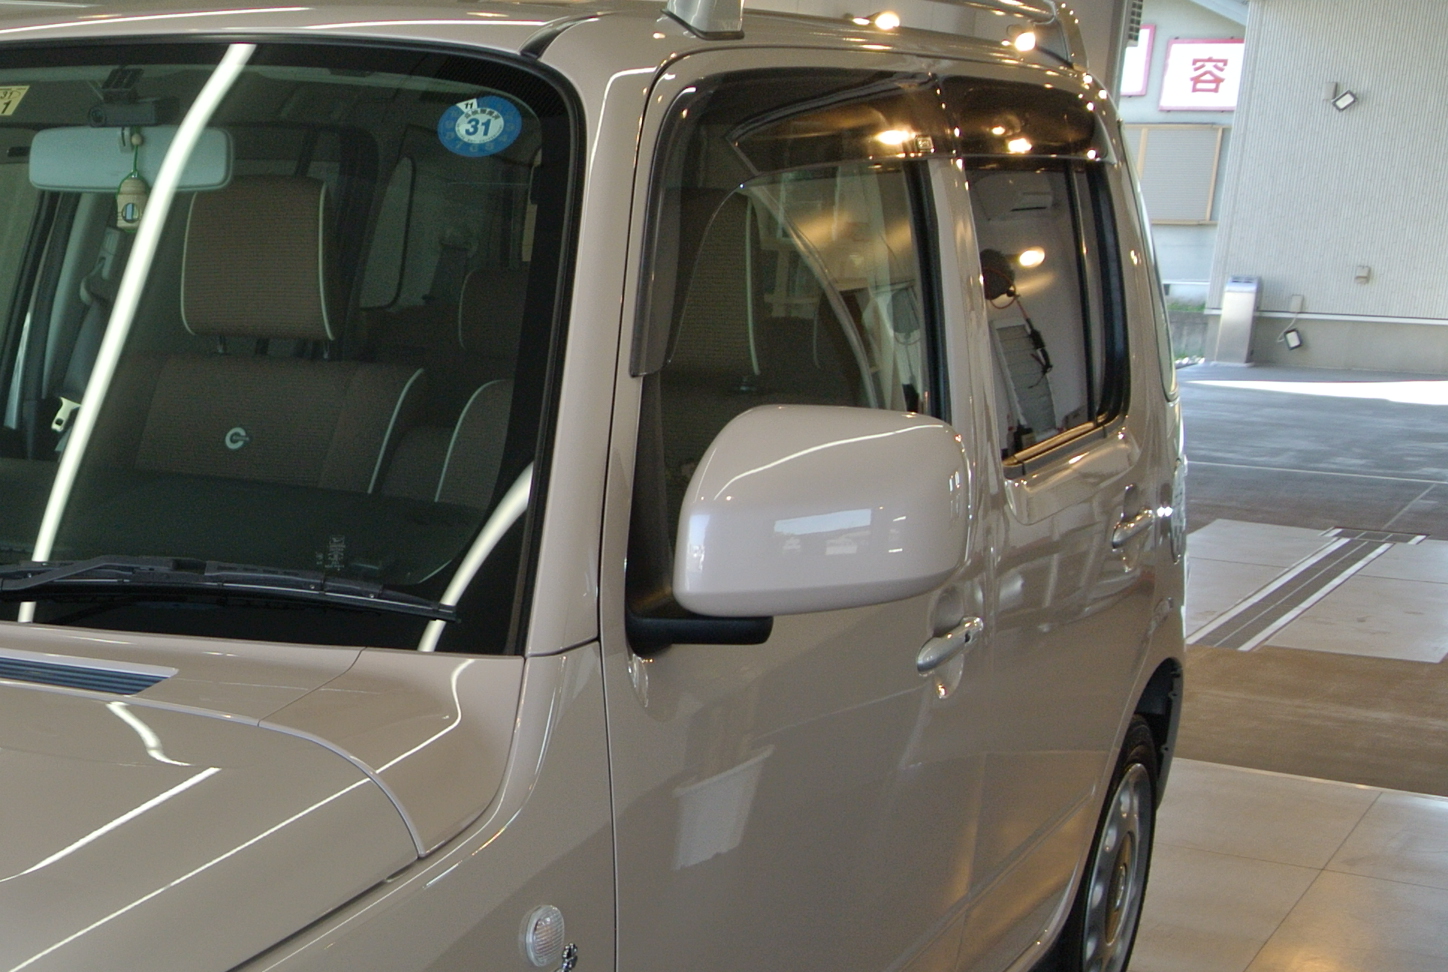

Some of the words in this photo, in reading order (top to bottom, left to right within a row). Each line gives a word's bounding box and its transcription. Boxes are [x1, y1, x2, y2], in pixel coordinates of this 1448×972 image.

[1189, 56, 1229, 94] 容
[0, 90, 14, 99] 31
[464, 117, 492, 137] 31
